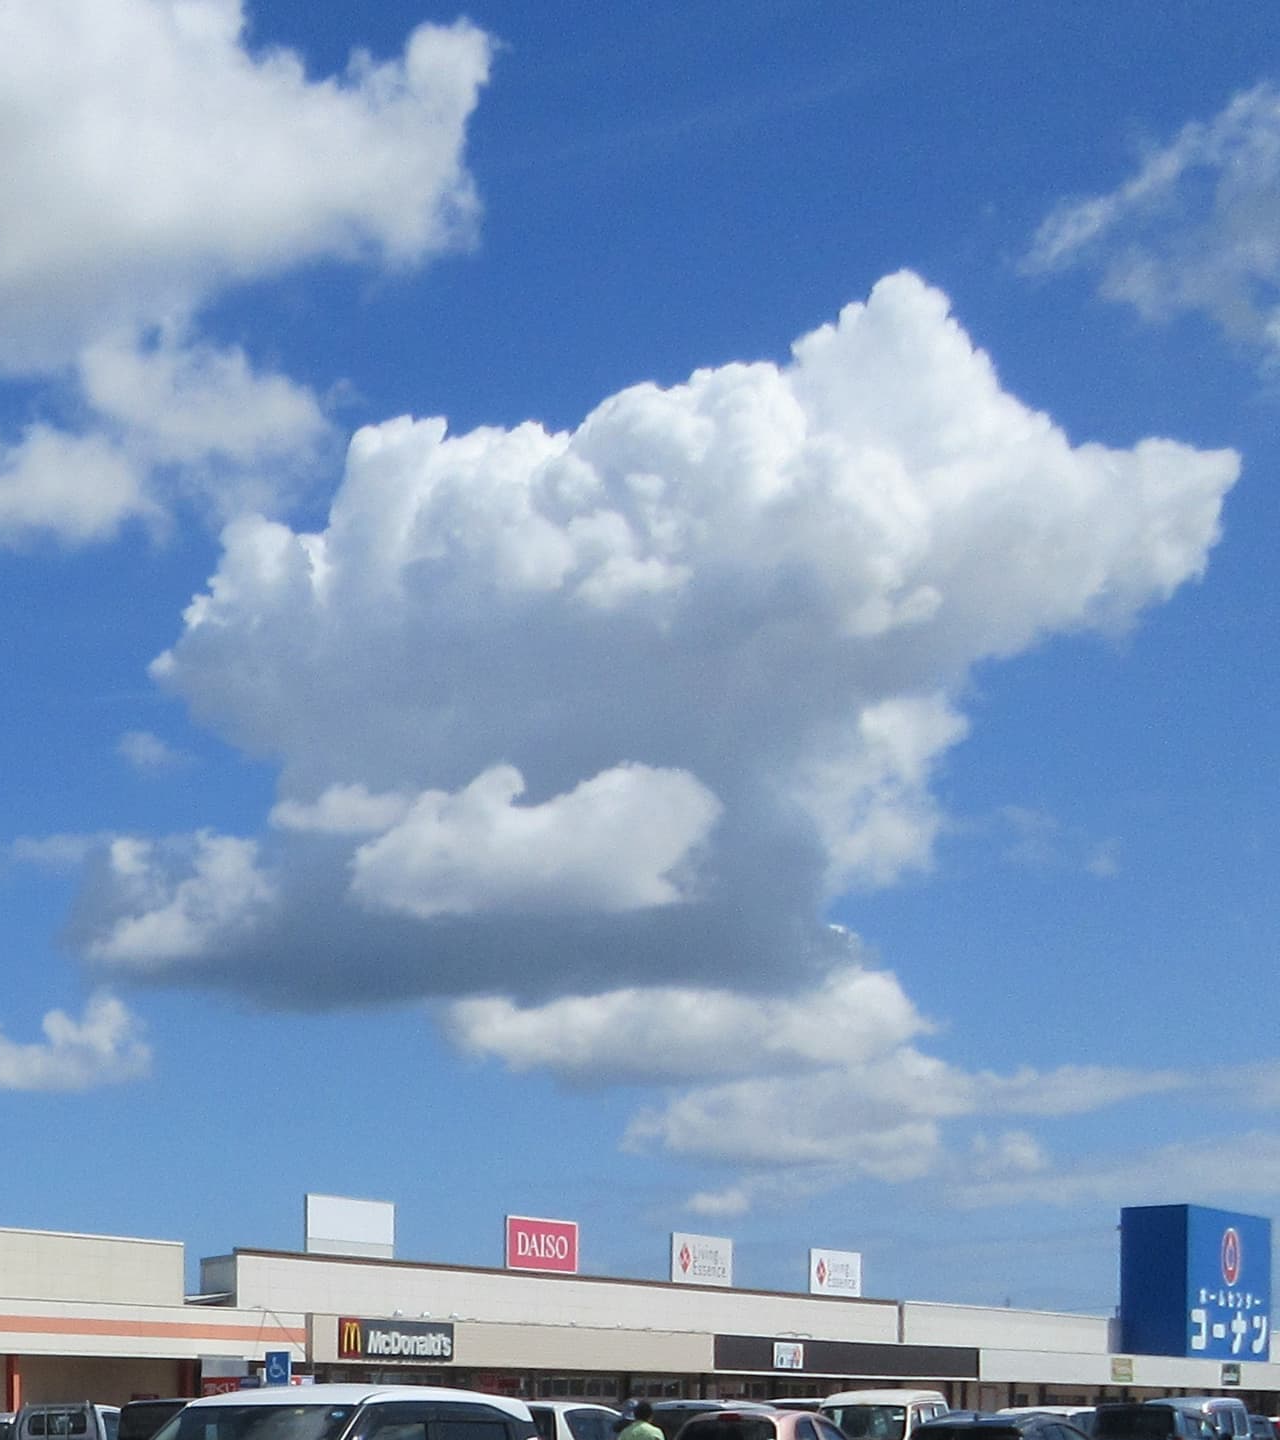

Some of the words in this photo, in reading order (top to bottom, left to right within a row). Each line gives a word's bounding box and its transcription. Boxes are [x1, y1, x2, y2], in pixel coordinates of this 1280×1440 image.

[517, 1231, 569, 1259] DAISO
[366, 1329, 453, 1357] McDonald's
[1190, 1308, 1268, 1355] コーナン
